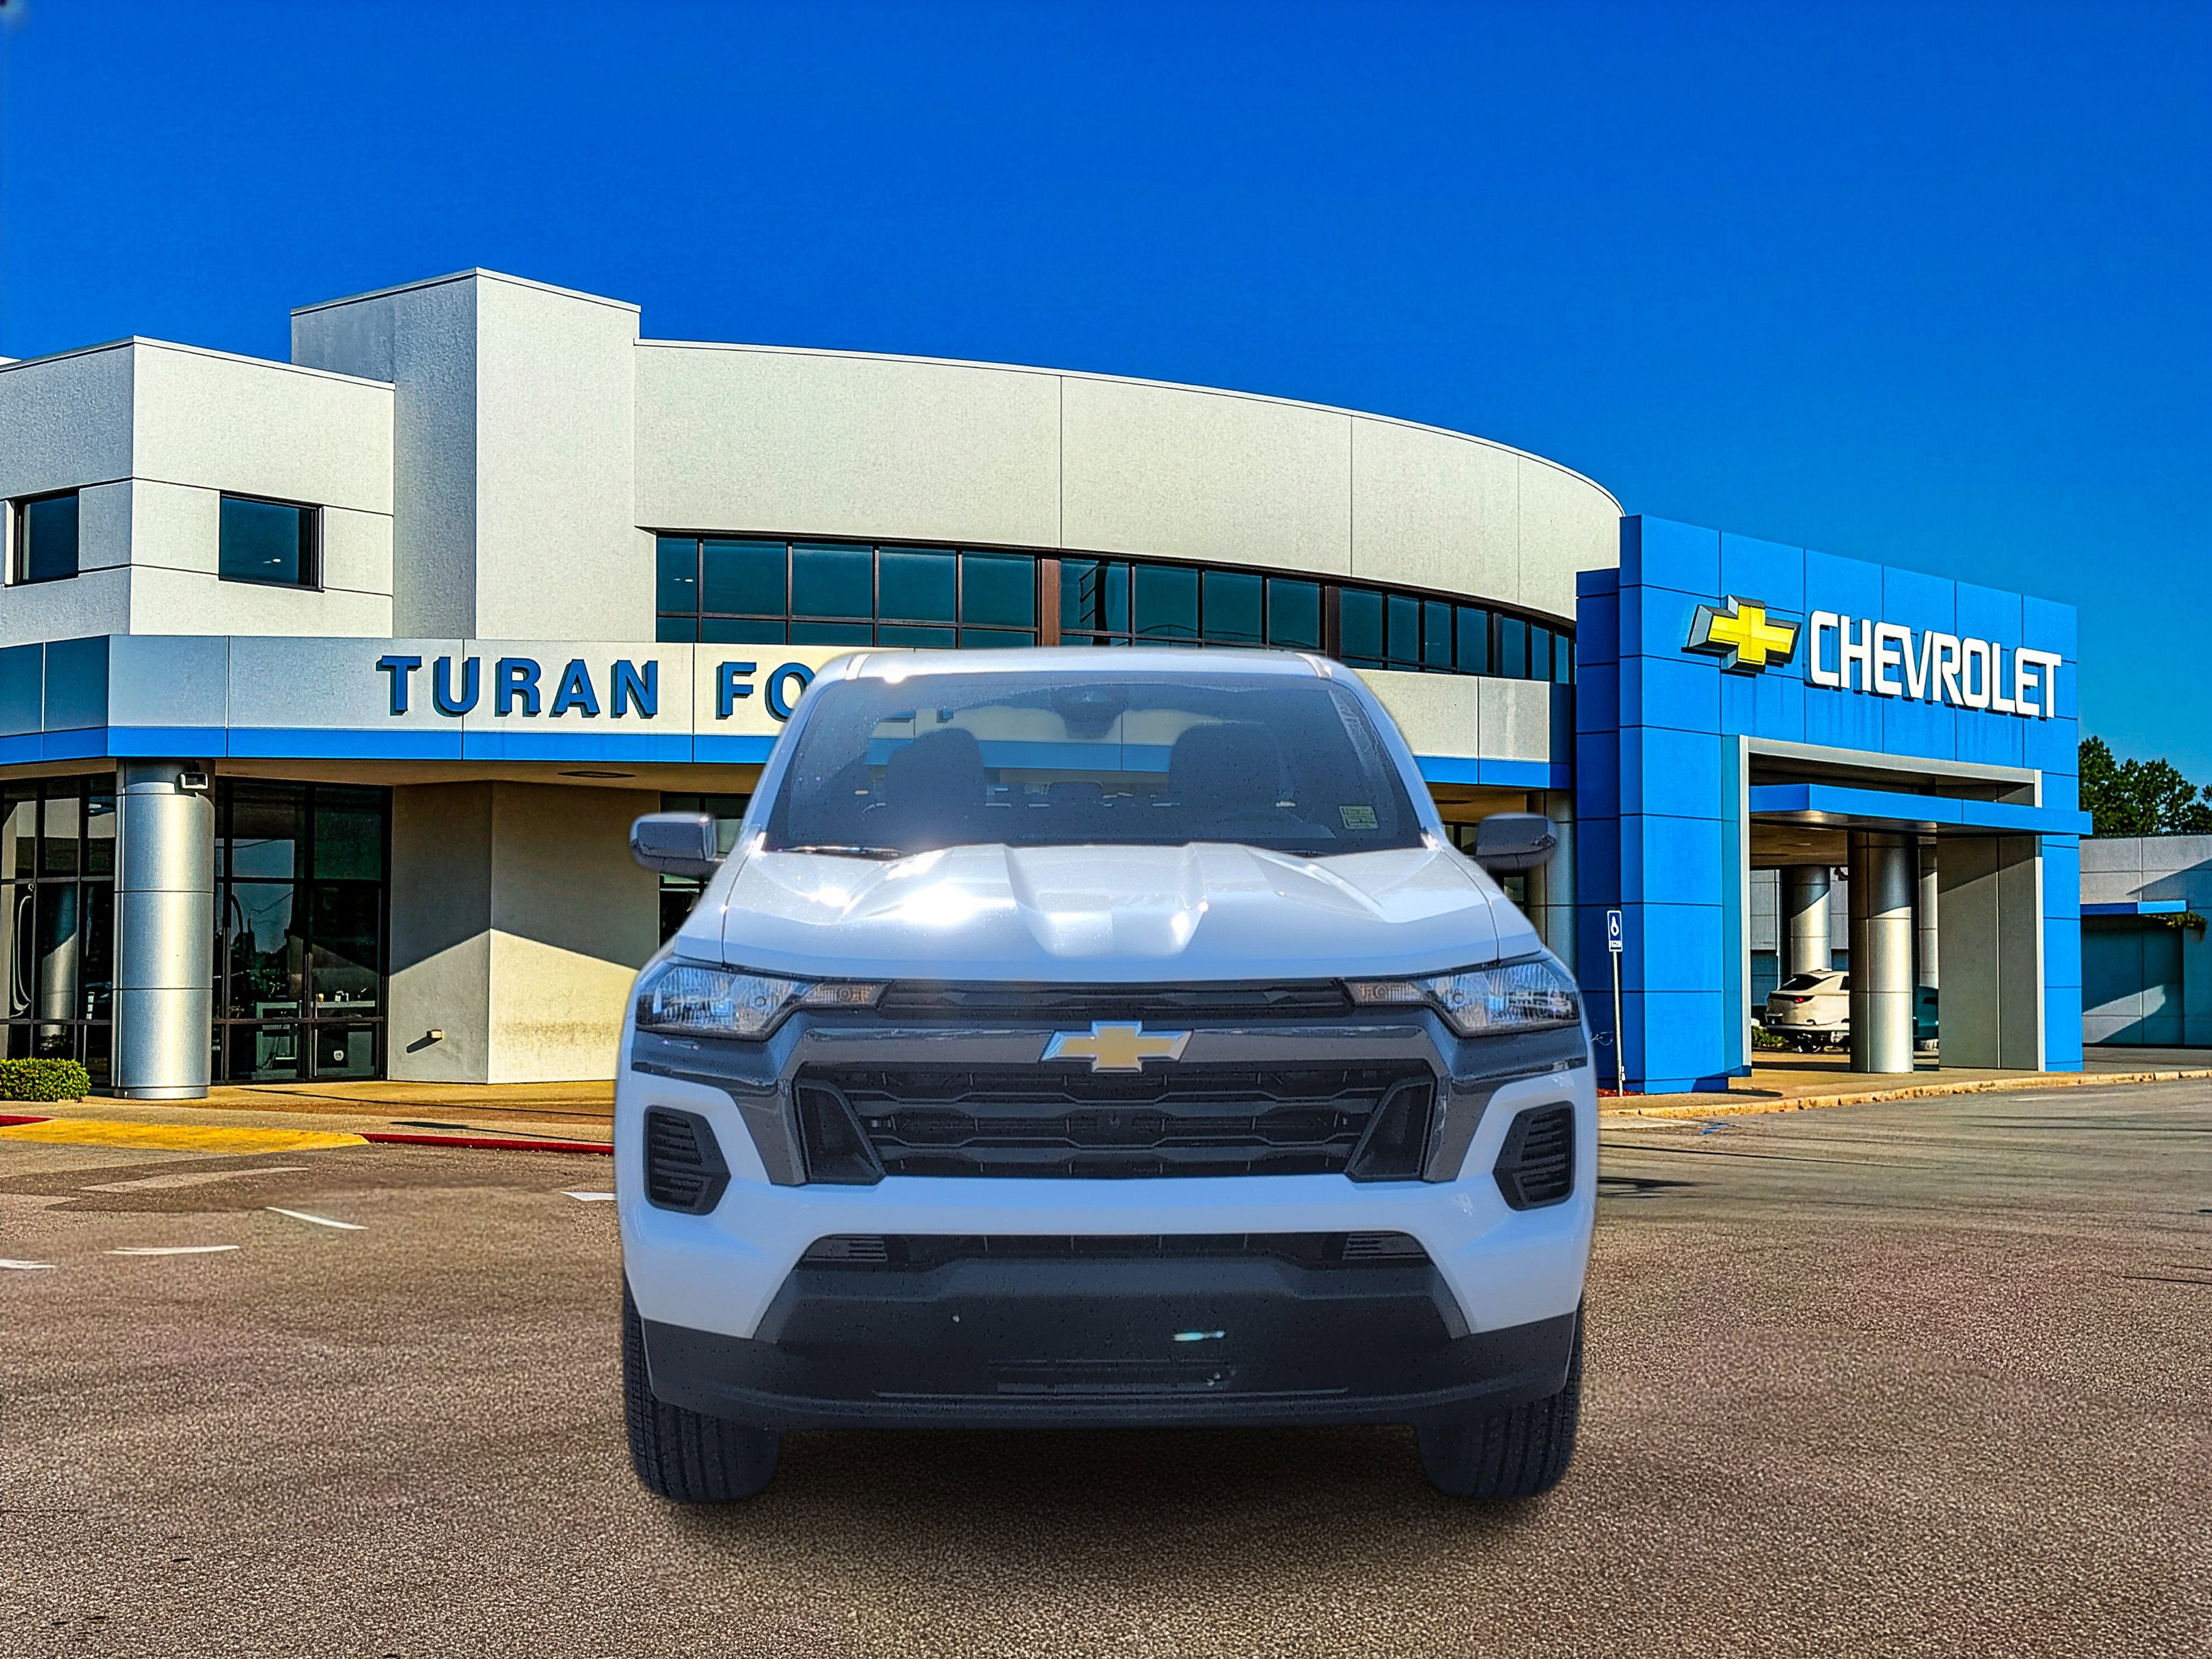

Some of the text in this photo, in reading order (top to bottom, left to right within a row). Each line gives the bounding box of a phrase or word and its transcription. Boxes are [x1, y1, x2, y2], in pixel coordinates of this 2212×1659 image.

[376, 655, 816, 723] TURAN FO
[1809, 610, 2062, 718] CHEVROLET
